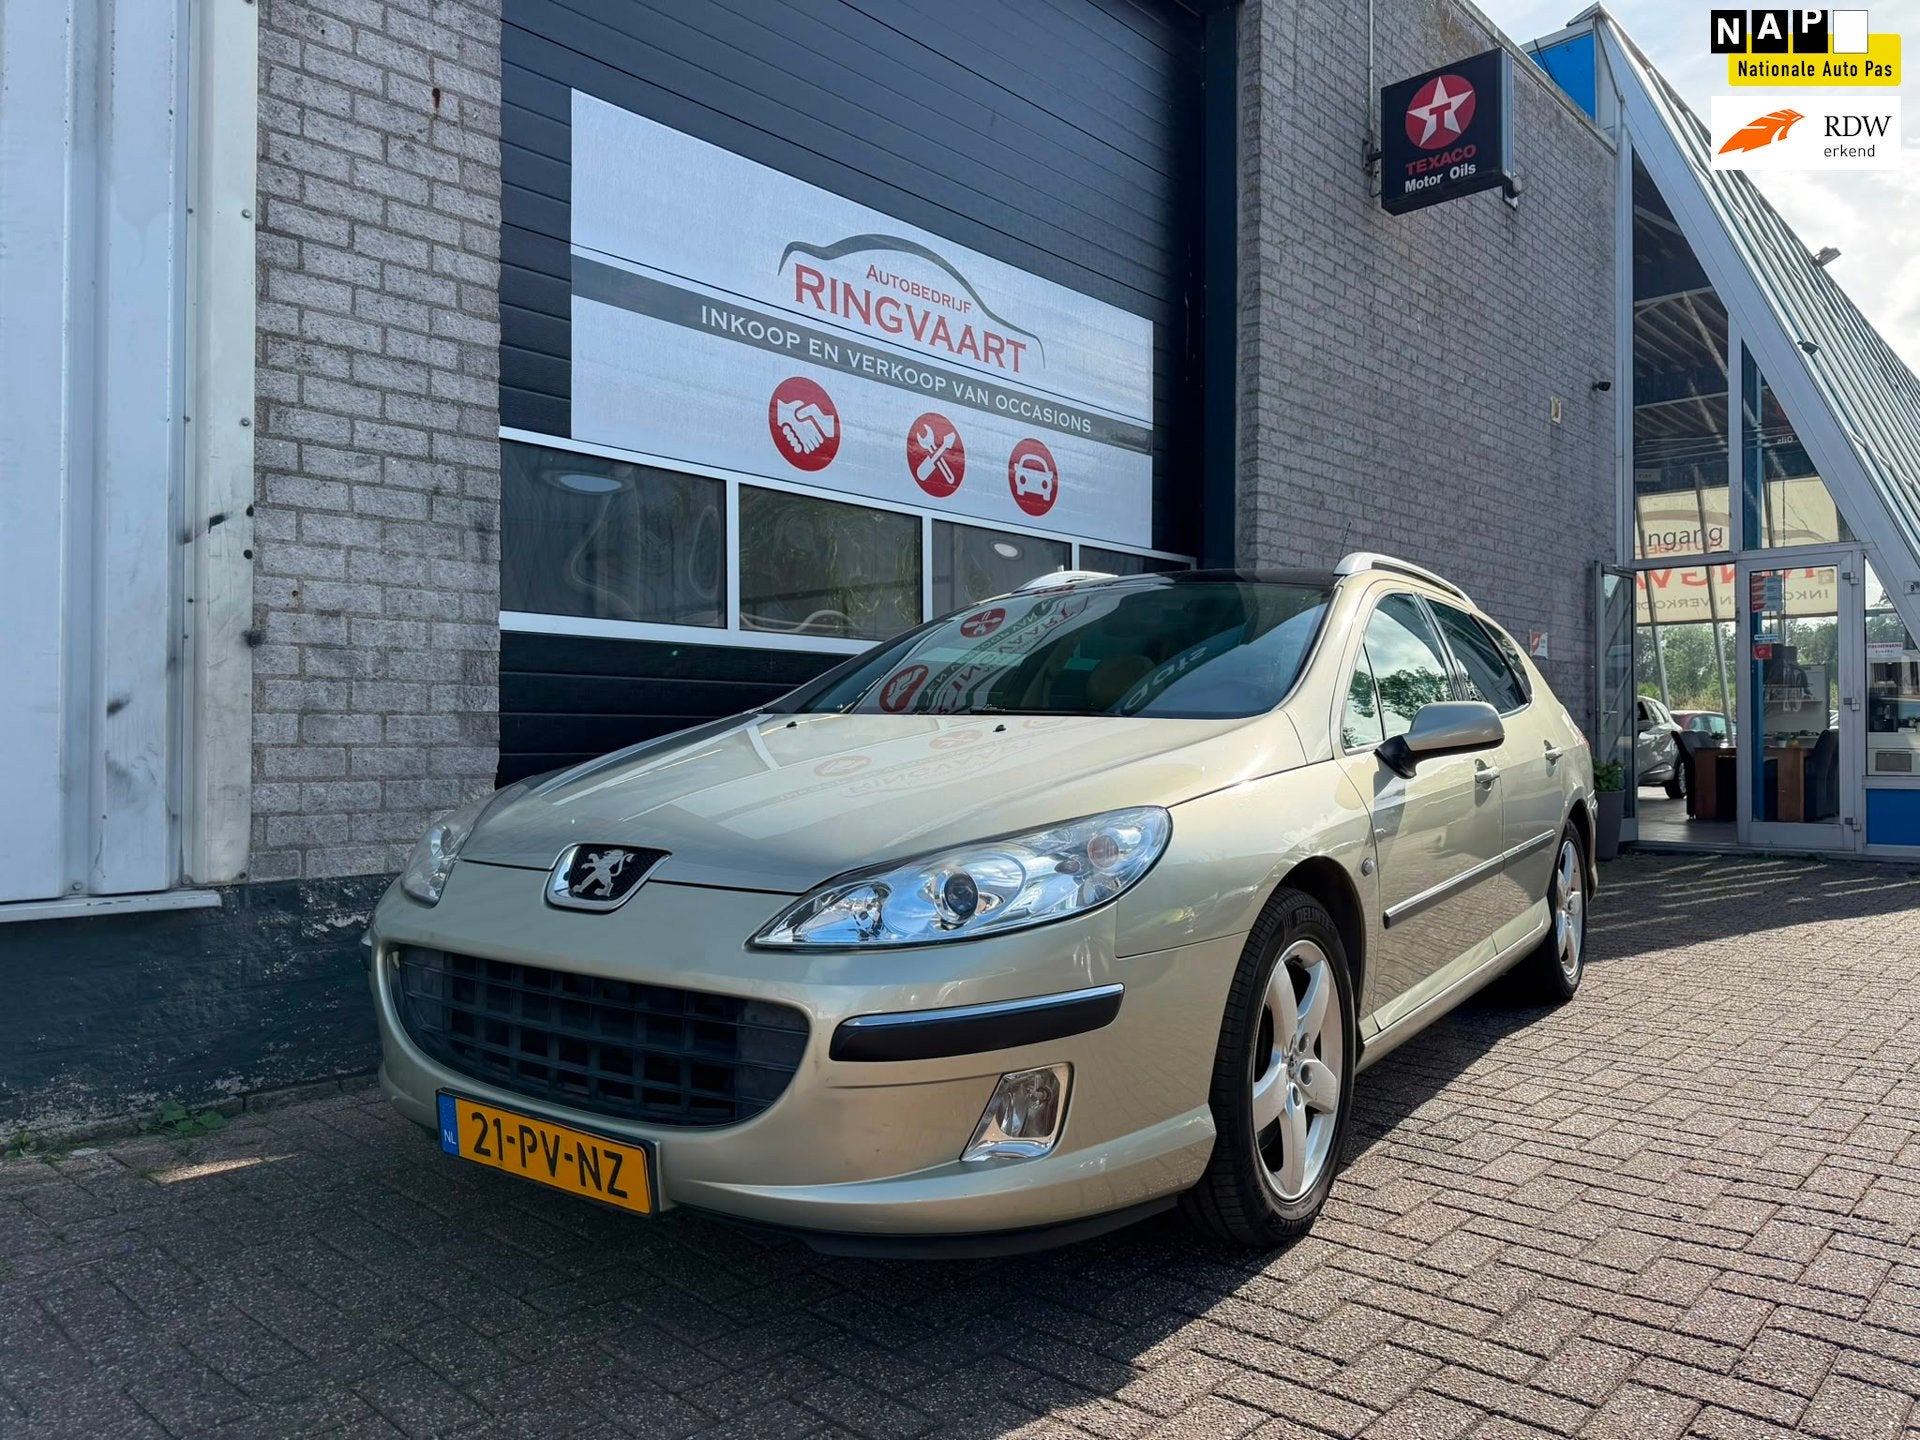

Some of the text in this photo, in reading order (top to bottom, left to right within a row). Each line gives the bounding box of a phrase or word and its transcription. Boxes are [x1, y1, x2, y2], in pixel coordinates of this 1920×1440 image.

[1405, 144, 1477, 176] TEXACO
[1405, 163, 1477, 193] Motor Oils
[866, 264, 972, 314] AUTOBEDRIJF
[794, 263, 1027, 373] RINGVAART
[701, 305, 1092, 433] INKOOP EN VERKOOP VAN OCCASIONS
[443, 1129, 457, 1145] NL
[471, 1112, 628, 1199] 21-PV-NZ
